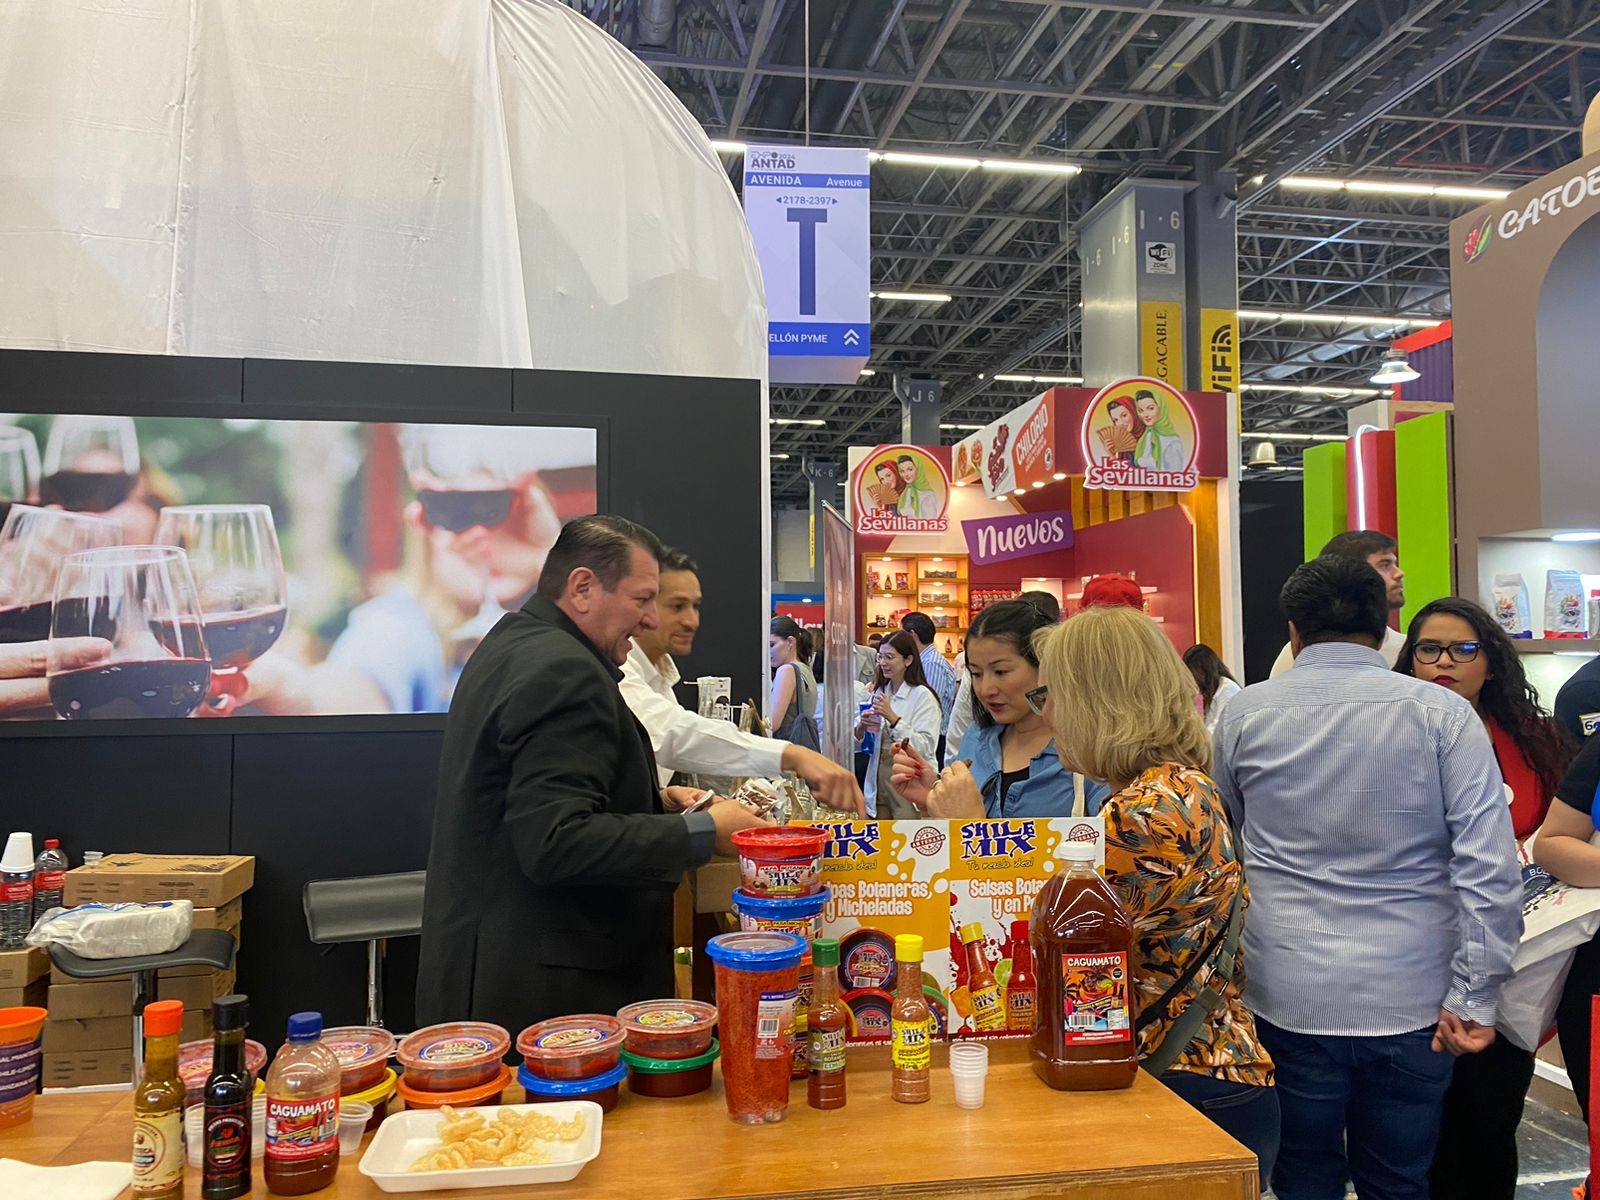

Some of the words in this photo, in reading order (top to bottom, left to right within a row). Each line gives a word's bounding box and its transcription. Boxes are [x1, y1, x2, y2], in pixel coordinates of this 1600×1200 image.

[751, 159, 795, 169] ANTAD
[750, 175, 802, 185] AVENIDA
[826, 177, 863, 187] Avenue
[783, 196, 832, 205] 2178-2397
[787, 207, 828, 315] T
[801, 334, 828, 343] PYME
[1156, 311, 1168, 382] GACABLE
[928, 390, 935, 402] 6
[1016, 403, 1048, 466] CHILORIO
[1103, 457, 1129, 470] Las
[1091, 467, 1195, 487] Sevillanas
[862, 516, 947, 530] Sevillanas
[872, 509, 893, 518] Las
[809, 822, 879, 840] ILE
[961, 820, 1035, 839] SHILE
[961, 835, 1036, 860] MIX
[858, 880, 933, 900] Botaneras,
[969, 878, 1013, 898] Salsas
[838, 898, 913, 917] Micheladas
[991, 896, 1002, 919] y
[1004, 897, 1021, 914] en
[1067, 955, 1122, 967] CAGUAMATO
[270, 1098, 336, 1118] CAGUAMATO
